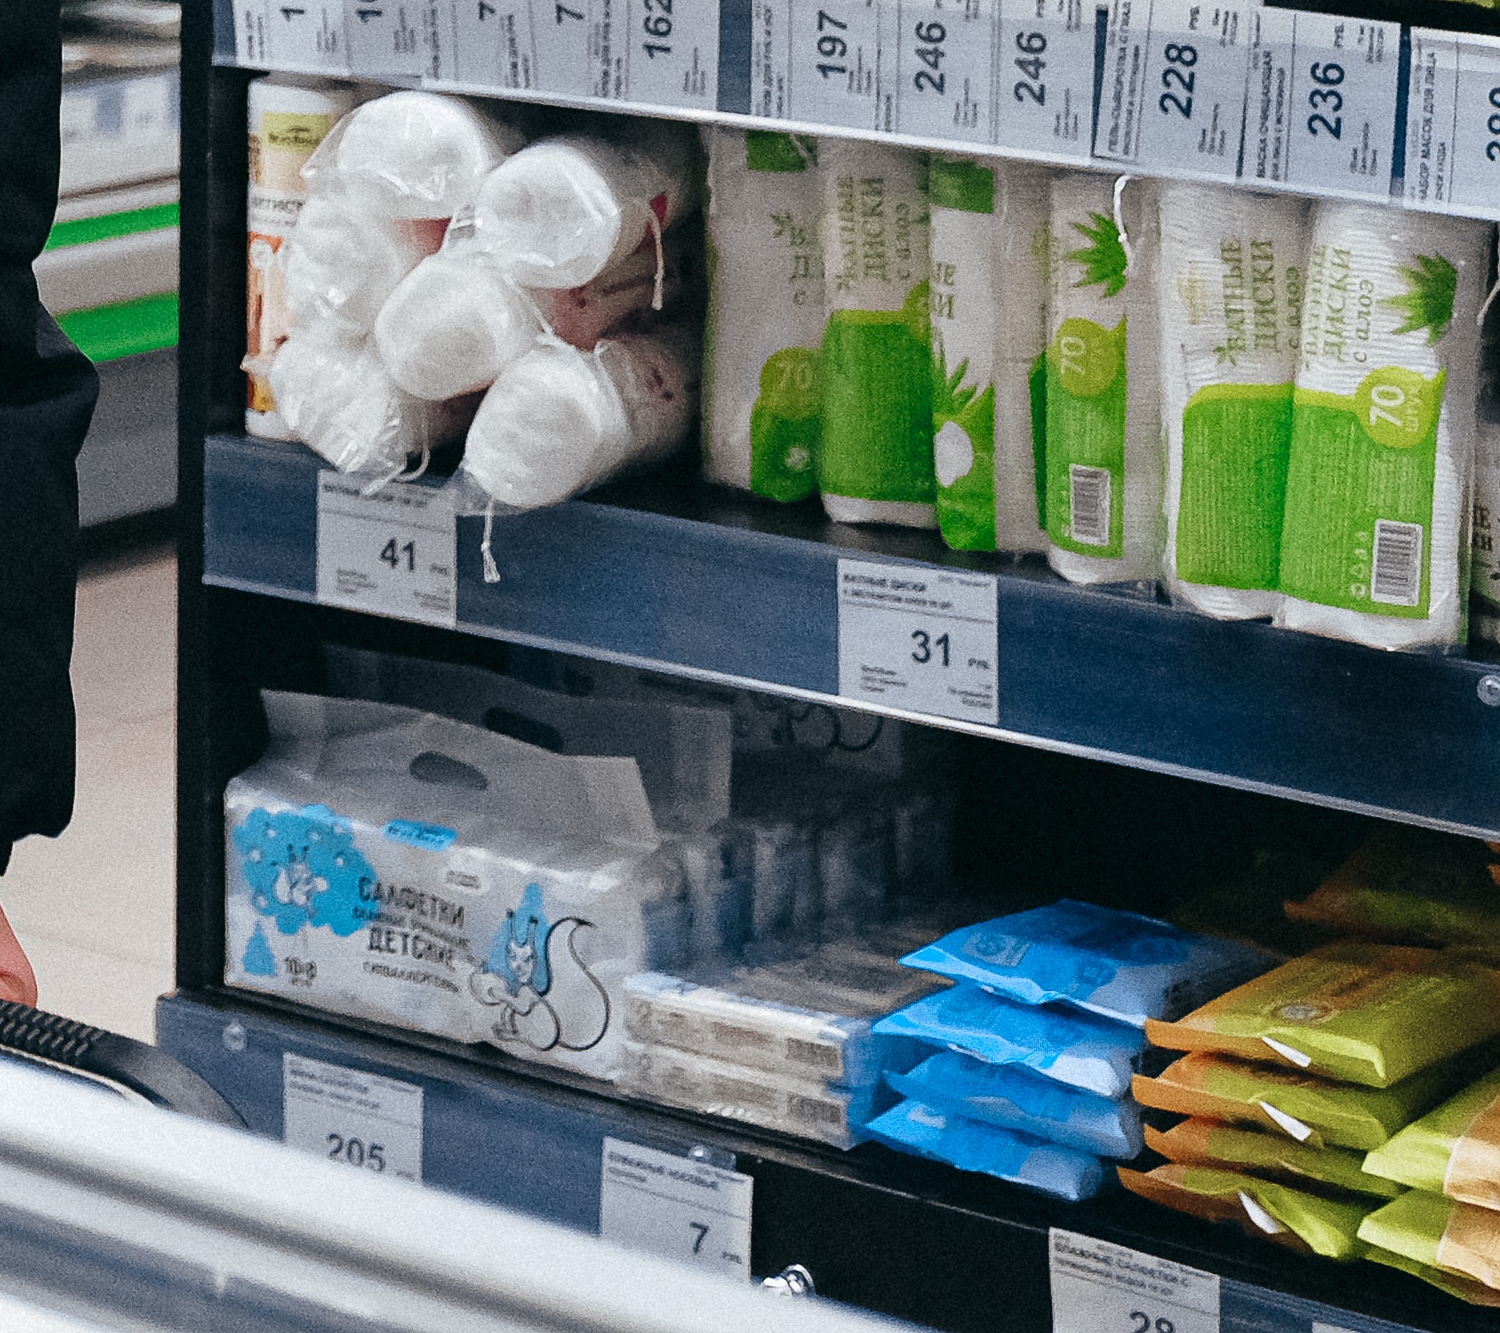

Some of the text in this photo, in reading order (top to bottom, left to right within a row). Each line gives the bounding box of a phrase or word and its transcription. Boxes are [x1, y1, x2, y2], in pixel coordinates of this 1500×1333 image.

[815, 9, 848, 81] 197
[913, 20, 947, 96] 246
[1013, 31, 1047, 107] 246
[1158, 42, 1198, 120] 228
[1307, 61, 1345, 140] 236
[1221, 235, 1247, 353] ВАТНЫЕ
[1250, 237, 1279, 354] ДИСКИ
[1323, 247, 1352, 363] ДИСКИ
[1059, 335, 1087, 377] 70
[1369, 382, 1406, 428] 70
[378, 536, 416, 572] 41
[911, 629, 951, 668] 31
[358, 875, 466, 931] САЛФЕТКИ
[688, 1221, 710, 1256] 7
